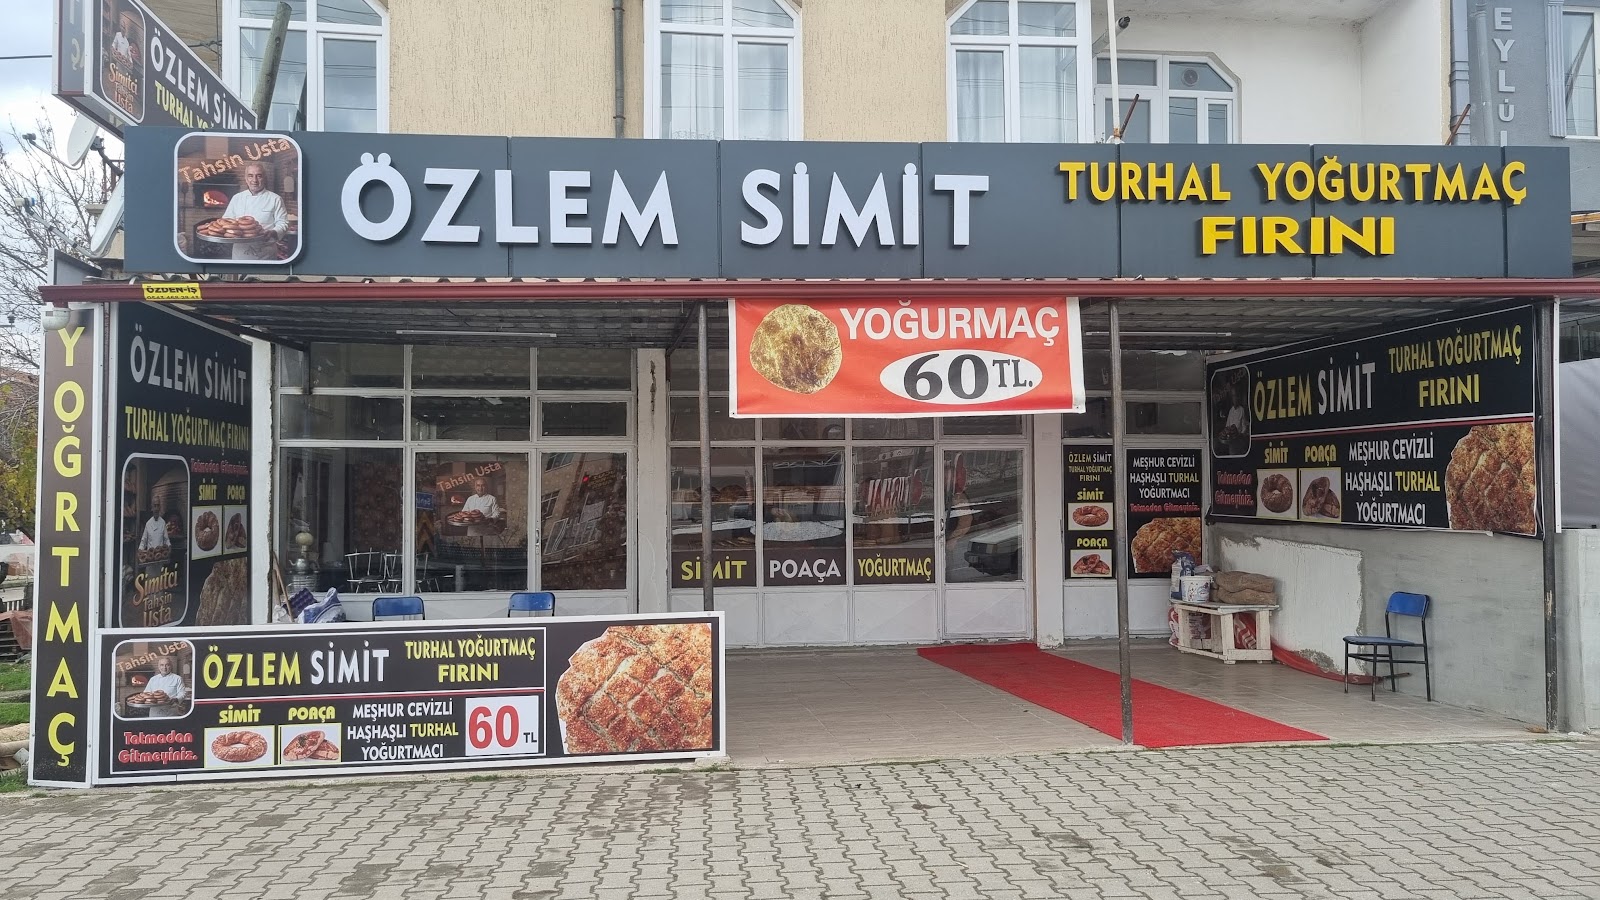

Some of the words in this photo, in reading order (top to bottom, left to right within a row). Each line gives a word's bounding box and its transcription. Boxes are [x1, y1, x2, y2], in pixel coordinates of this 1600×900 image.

[109, 63, 138, 96] Simitci
[150, 27, 209, 114] ÖZLEM
[113, 92, 133, 114] Usta
[154, 80, 194, 128] TURHAL
[178, 151, 244, 185] Tahsin
[245, 136, 291, 162] Usta
[1059, 161, 1232, 201] TURHAL
[1257, 155, 1527, 205] YOĞURTMAÇ
[341, 152, 679, 247] ÖZLEM
[740, 161, 990, 247] SİMİT
[1201, 216, 1395, 256] FIRINI
[839, 300, 1060, 346] YOĞURMAÇ
[1389, 343, 1434, 374] TURHAL
[1436, 324, 1522, 368] YOĞURTMAÇ
[130, 323, 200, 395] ÖZLEM
[204, 354, 247, 406] SİMİT
[903, 353, 989, 401] 60
[992, 359, 1034, 388] TL.
[1254, 370, 1312, 421] ÖZLEM
[1318, 352, 1376, 415] SİMİT
[1418, 373, 1480, 408] FIRINI
[125, 405, 169, 443] TURHAL
[171, 407, 225, 456] YOĞURTMAÇ
[227, 424, 249, 451] FIRINI
[1068, 451, 1091, 463] ÖZLEM
[1093, 450, 1112, 463] SİMİT
[1133, 456, 1165, 470] MEŞHUR
[1166, 454, 1195, 468] CEVİZLİ
[1264, 441, 1289, 463] SİMİT
[1304, 444, 1337, 466] POAÇA
[1348, 439, 1390, 465] MEŞHUR
[1392, 431, 1434, 460] CEVİZLİ
[198, 478, 217, 501] SİMİT
[436, 472, 475, 493] Tahsin
[475, 460, 503, 479] Usta
[1079, 474, 1101, 482] FIRINI
[1130, 472, 1167, 486] HAŞHAŞLI
[1168, 472, 1199, 483] TURHAL
[1345, 471, 1392, 496] HAŞHAŞLI
[1395, 470, 1440, 492] TURHAL
[1076, 488, 1104, 501] SİMİT
[1139, 485, 1190, 499] YOĞURTMACI
[1356, 497, 1426, 525] YOĞURTMACI
[45, 326, 86, 767] YOĞRTMAÇ
[1076, 538, 1108, 549] POAÇA
[681, 555, 747, 581] SİMİT
[769, 558, 842, 583] POAÇA
[857, 553, 932, 582] YOĞURTMAÇ
[133, 562, 178, 606] Simitci
[143, 592, 172, 611] Tahsin
[143, 606, 172, 628] Usta
[117, 652, 157, 673] Tahsin
[158, 640, 188, 658] Usta
[405, 639, 455, 660] TURHAL
[457, 633, 536, 661] YOĞURTMAÇ
[203, 645, 301, 689] ÖZLEM
[310, 640, 390, 686] SİMİT
[438, 663, 499, 683] FIRINI
[218, 704, 261, 723] SİMİT
[287, 705, 336, 723] POAÇA
[352, 701, 404, 721] MEŞHUR
[407, 698, 453, 717] CEVİZLİ
[123, 731, 193, 745] Tatmadan
[347, 724, 406, 743] HAŞHAŞLI
[409, 722, 459, 738] TURHAL
[468, 705, 520, 750] 60
[523, 732, 538, 744] TL
[118, 748, 198, 765] Gitmeyiniz.
[361, 742, 444, 760] YOĞURTMACI
